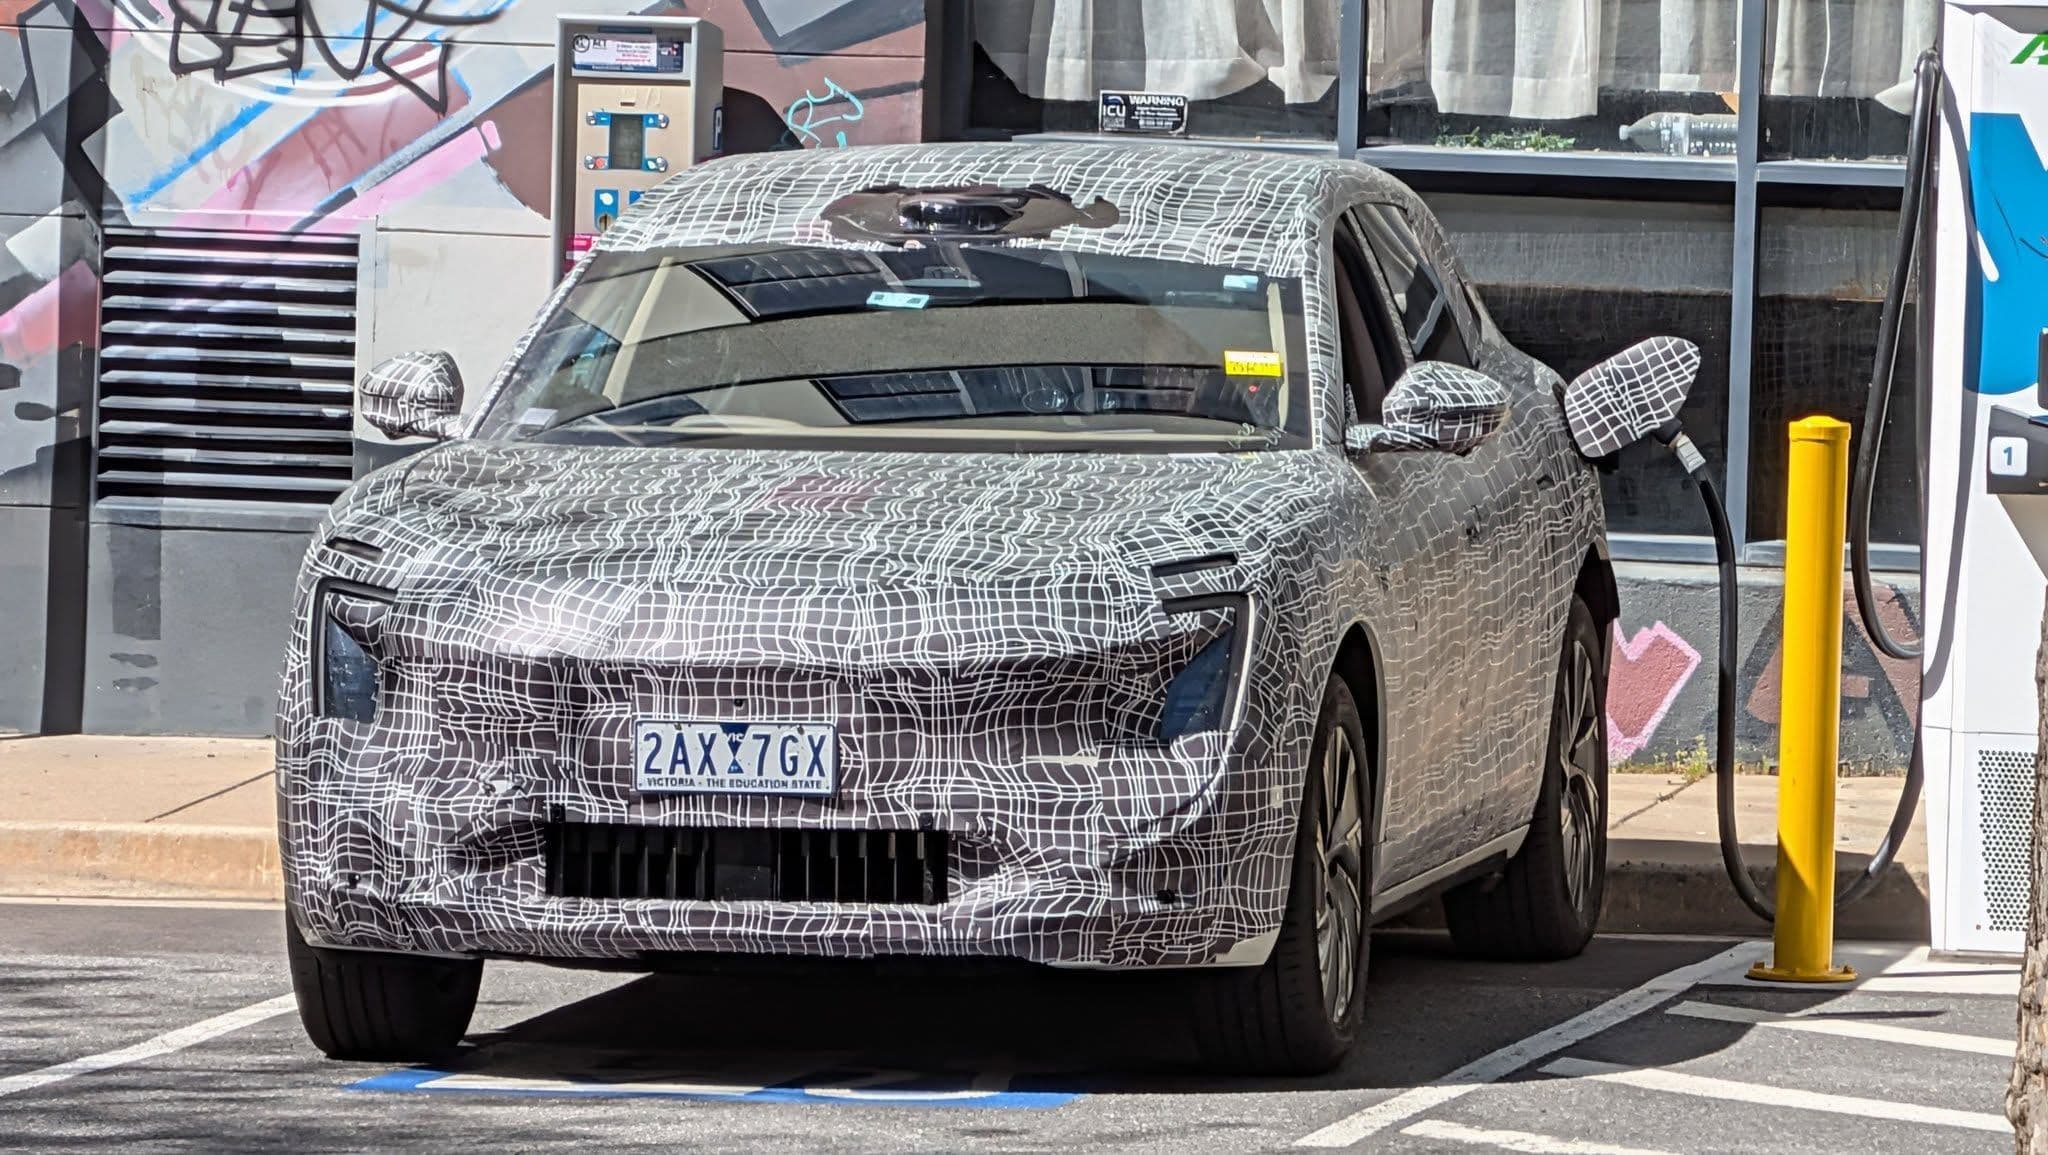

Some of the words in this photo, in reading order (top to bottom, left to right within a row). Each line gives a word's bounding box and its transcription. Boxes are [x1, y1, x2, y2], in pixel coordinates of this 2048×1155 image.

[1129, 95, 1184, 106] WARNING
[1103, 105, 1126, 117] ICU
[2003, 446, 2013, 466] 1
[647, 777, 695, 788] VICTORIA
[706, 778, 725, 788] THE
[729, 779, 789, 789] EDUCATION
[792, 779, 822, 790] STATE
